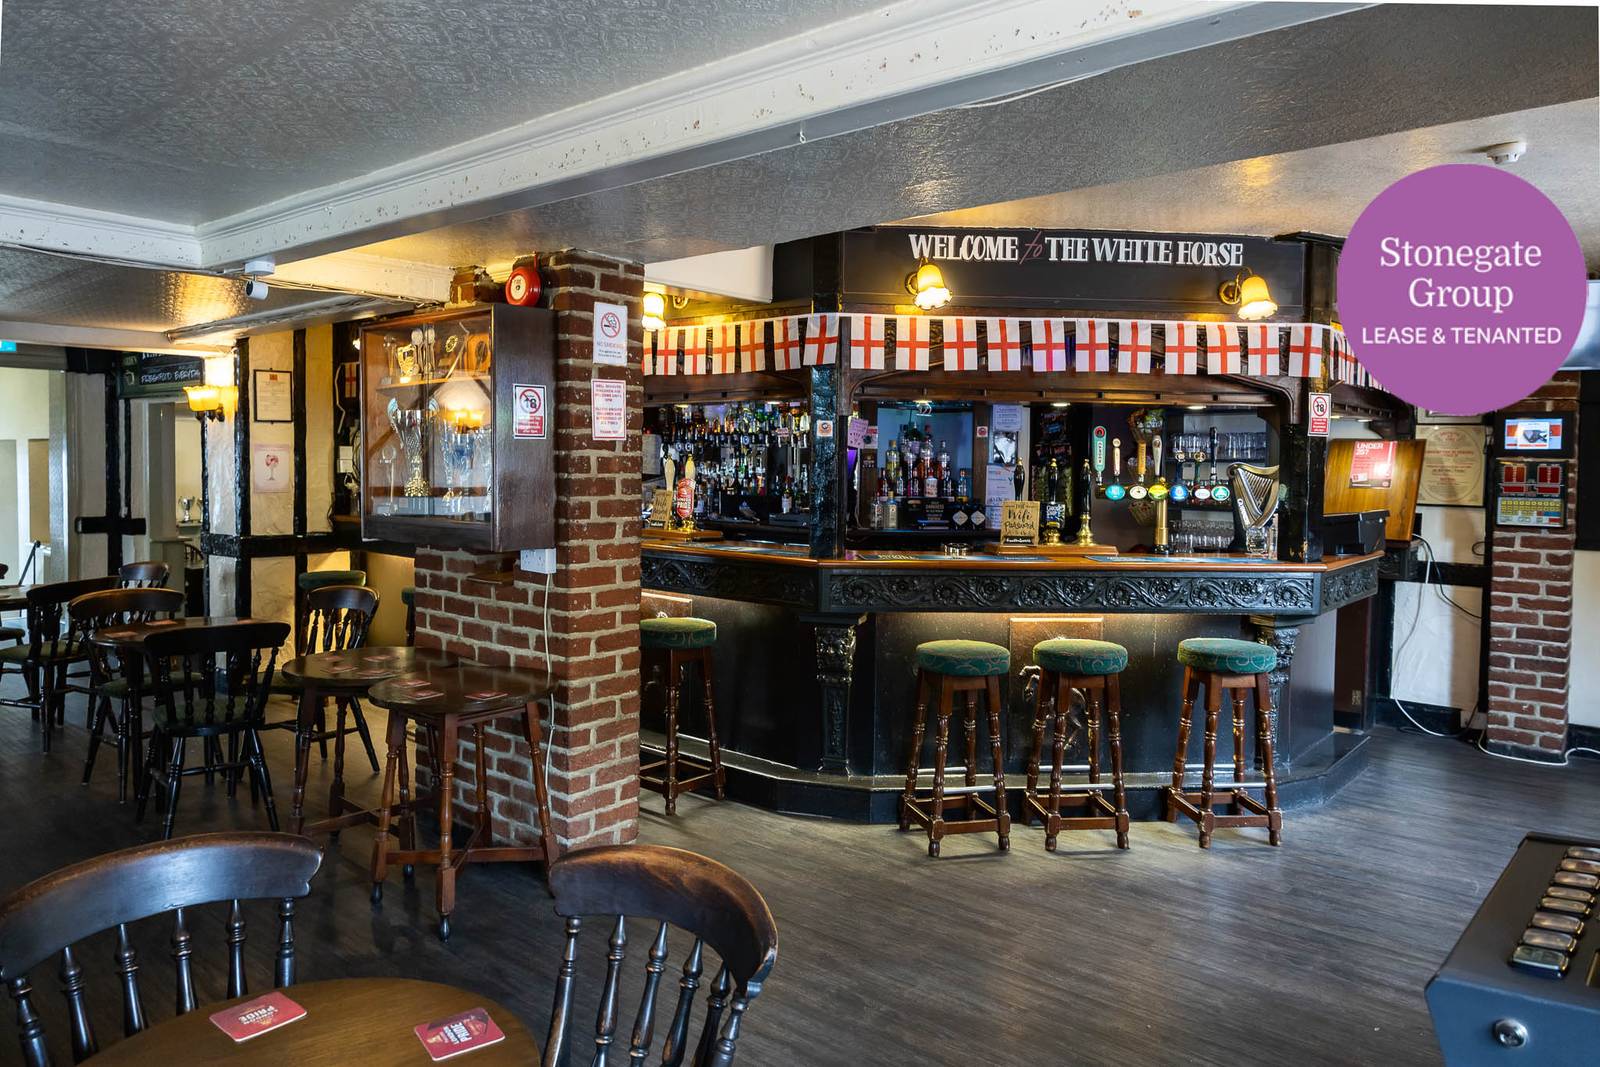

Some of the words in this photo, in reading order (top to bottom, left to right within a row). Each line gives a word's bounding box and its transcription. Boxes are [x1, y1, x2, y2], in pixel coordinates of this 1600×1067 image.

[908, 234, 1018, 261] WELCOME
[1019, 231, 1043, 265] to
[1044, 237, 1088, 262] THE
[1091, 237, 1172, 264] WHITE
[1175, 240, 1243, 267] HORSE
[1008, 508, 1032, 522] Wifi
[238, 1005, 276, 1024] PRIDE
[450, 1022, 473, 1043] PRIDE
